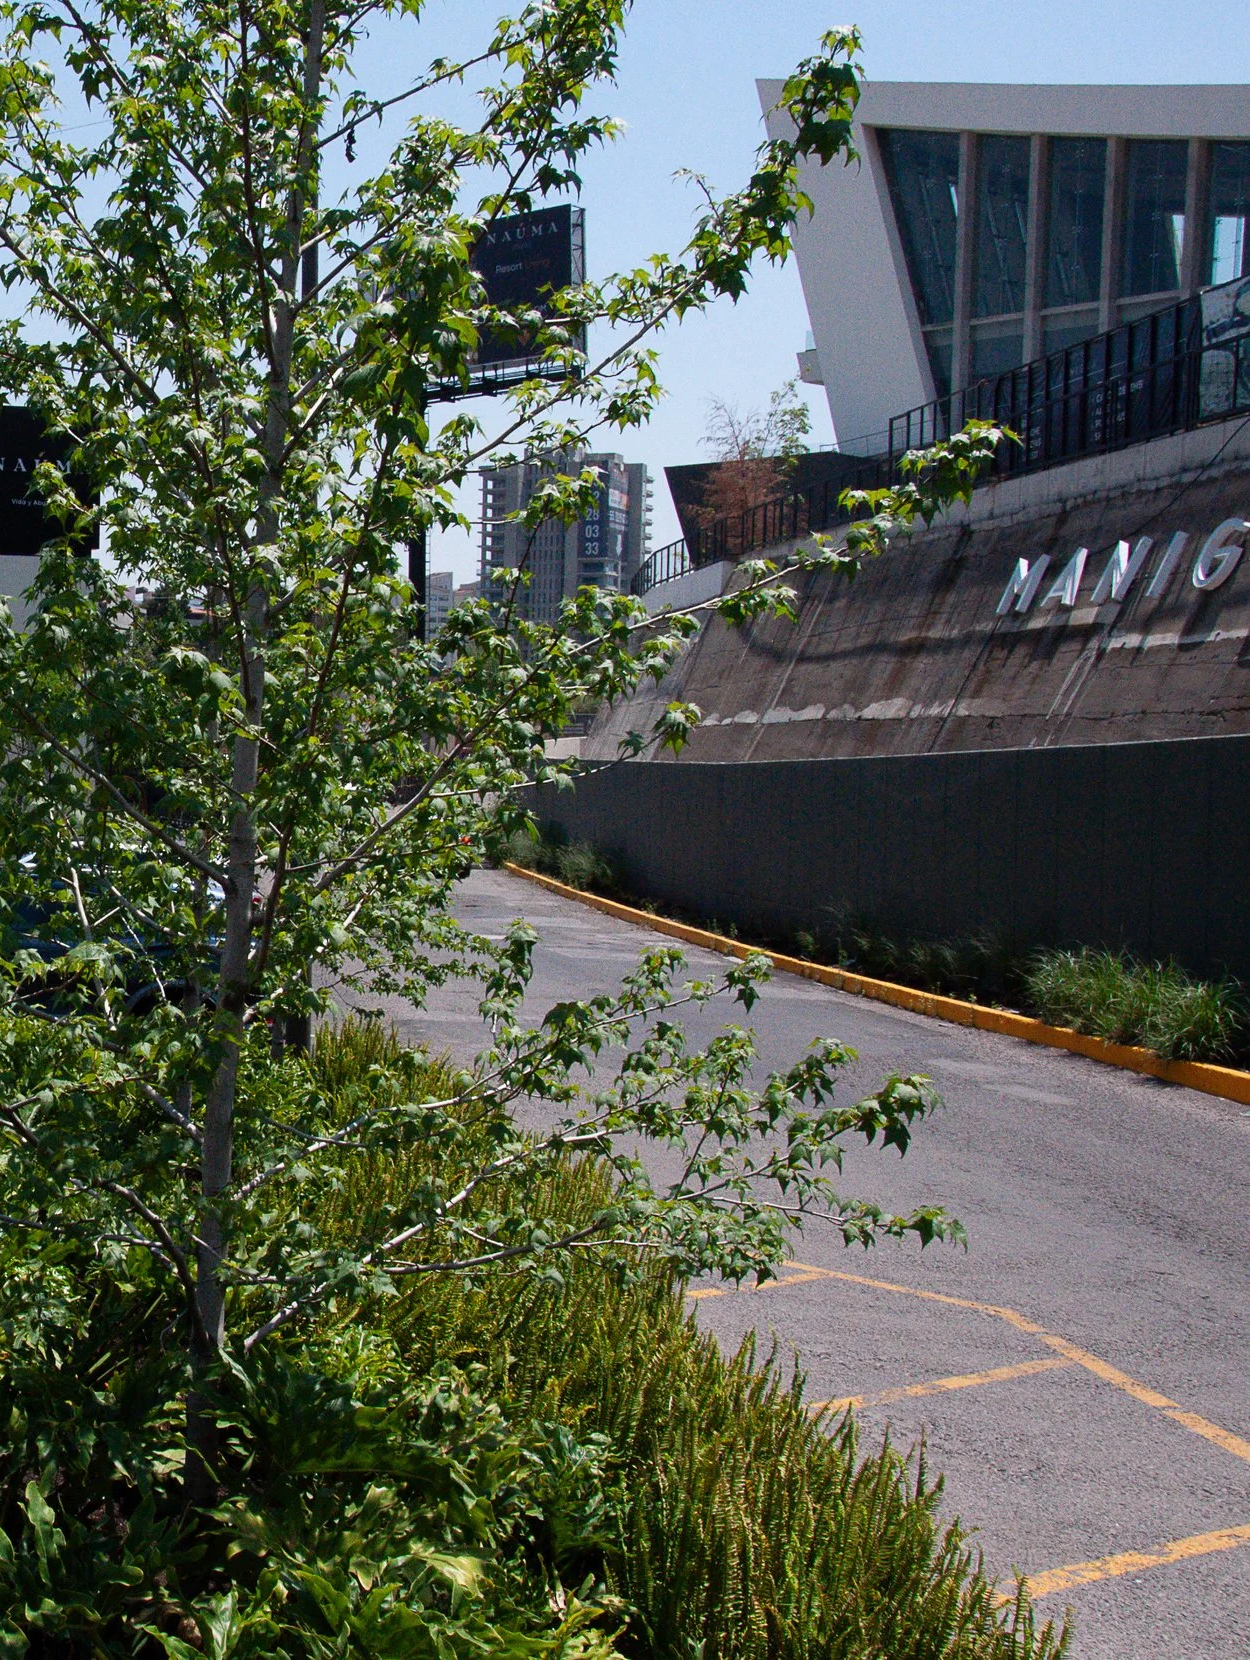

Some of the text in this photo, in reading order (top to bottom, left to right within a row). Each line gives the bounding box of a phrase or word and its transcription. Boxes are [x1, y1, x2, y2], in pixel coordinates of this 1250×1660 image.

[495, 261, 523, 274] Resort
[585, 525, 599, 538] 03
[585, 542, 599, 555] 33
